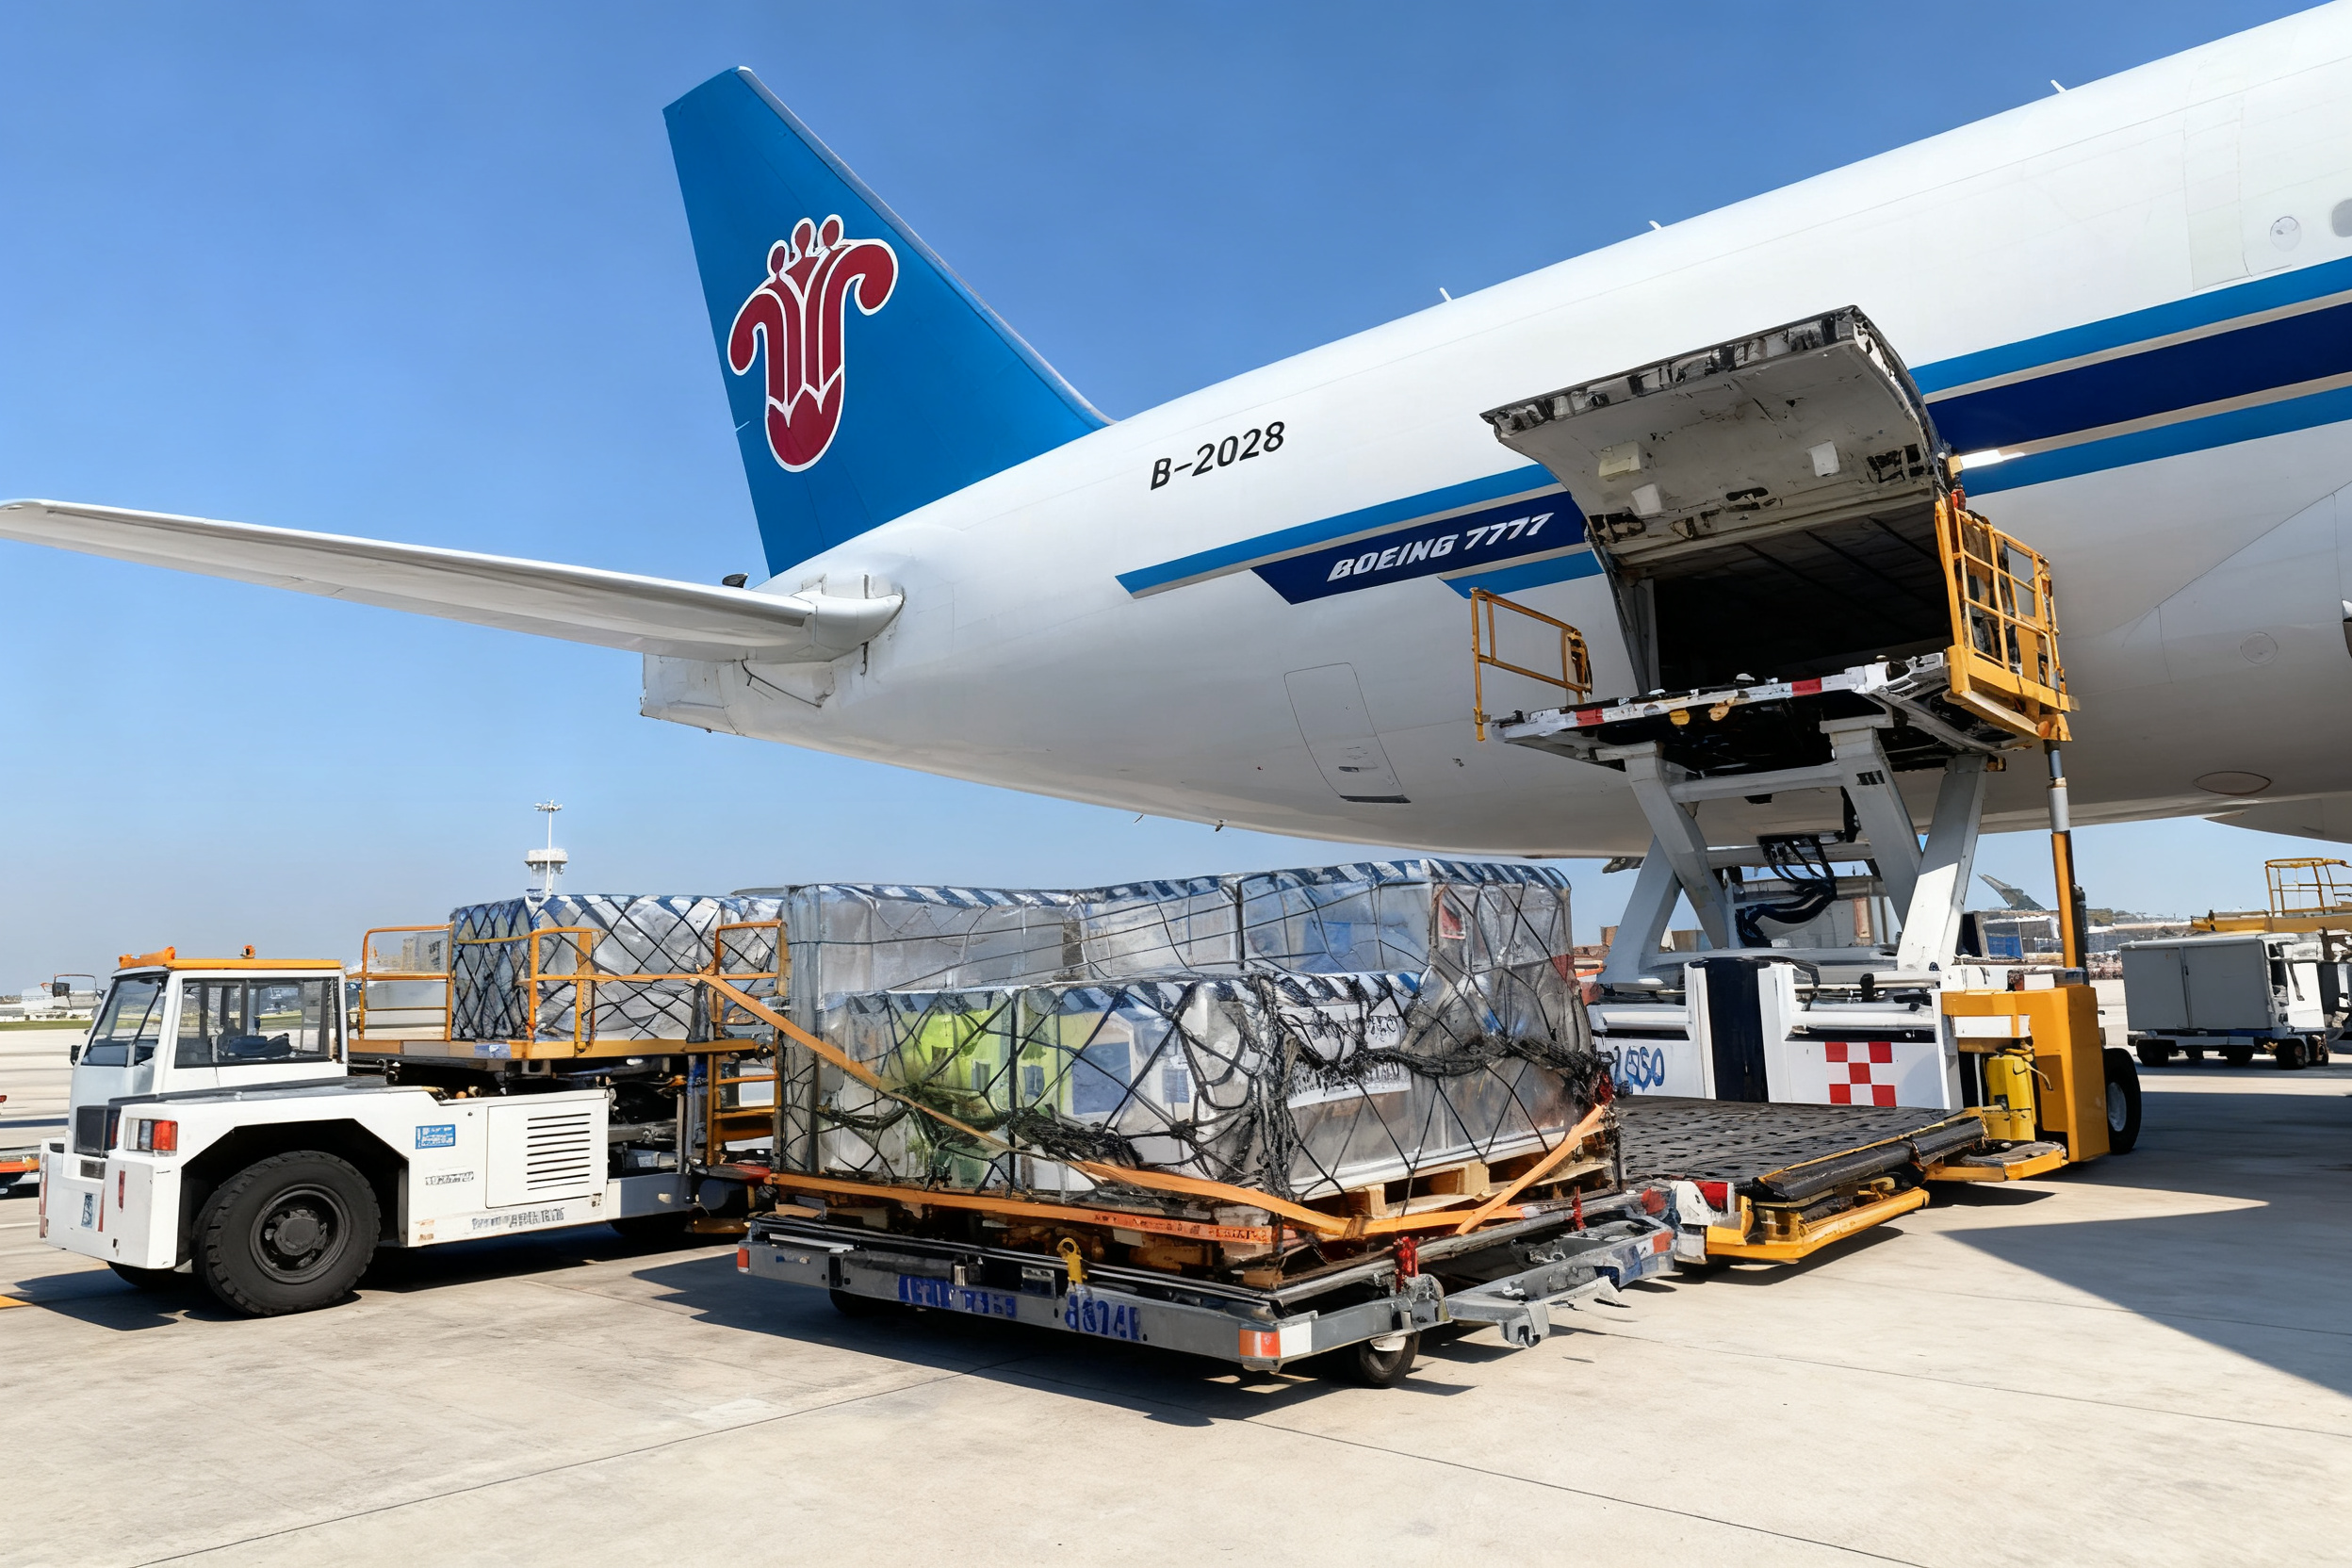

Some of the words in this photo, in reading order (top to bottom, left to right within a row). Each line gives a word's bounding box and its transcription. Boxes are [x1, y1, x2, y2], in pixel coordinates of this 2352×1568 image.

[1151, 421, 1284, 490] B-2028
[1328, 534, 1459, 581] BOEING
[1464, 513, 1555, 550] 7777
